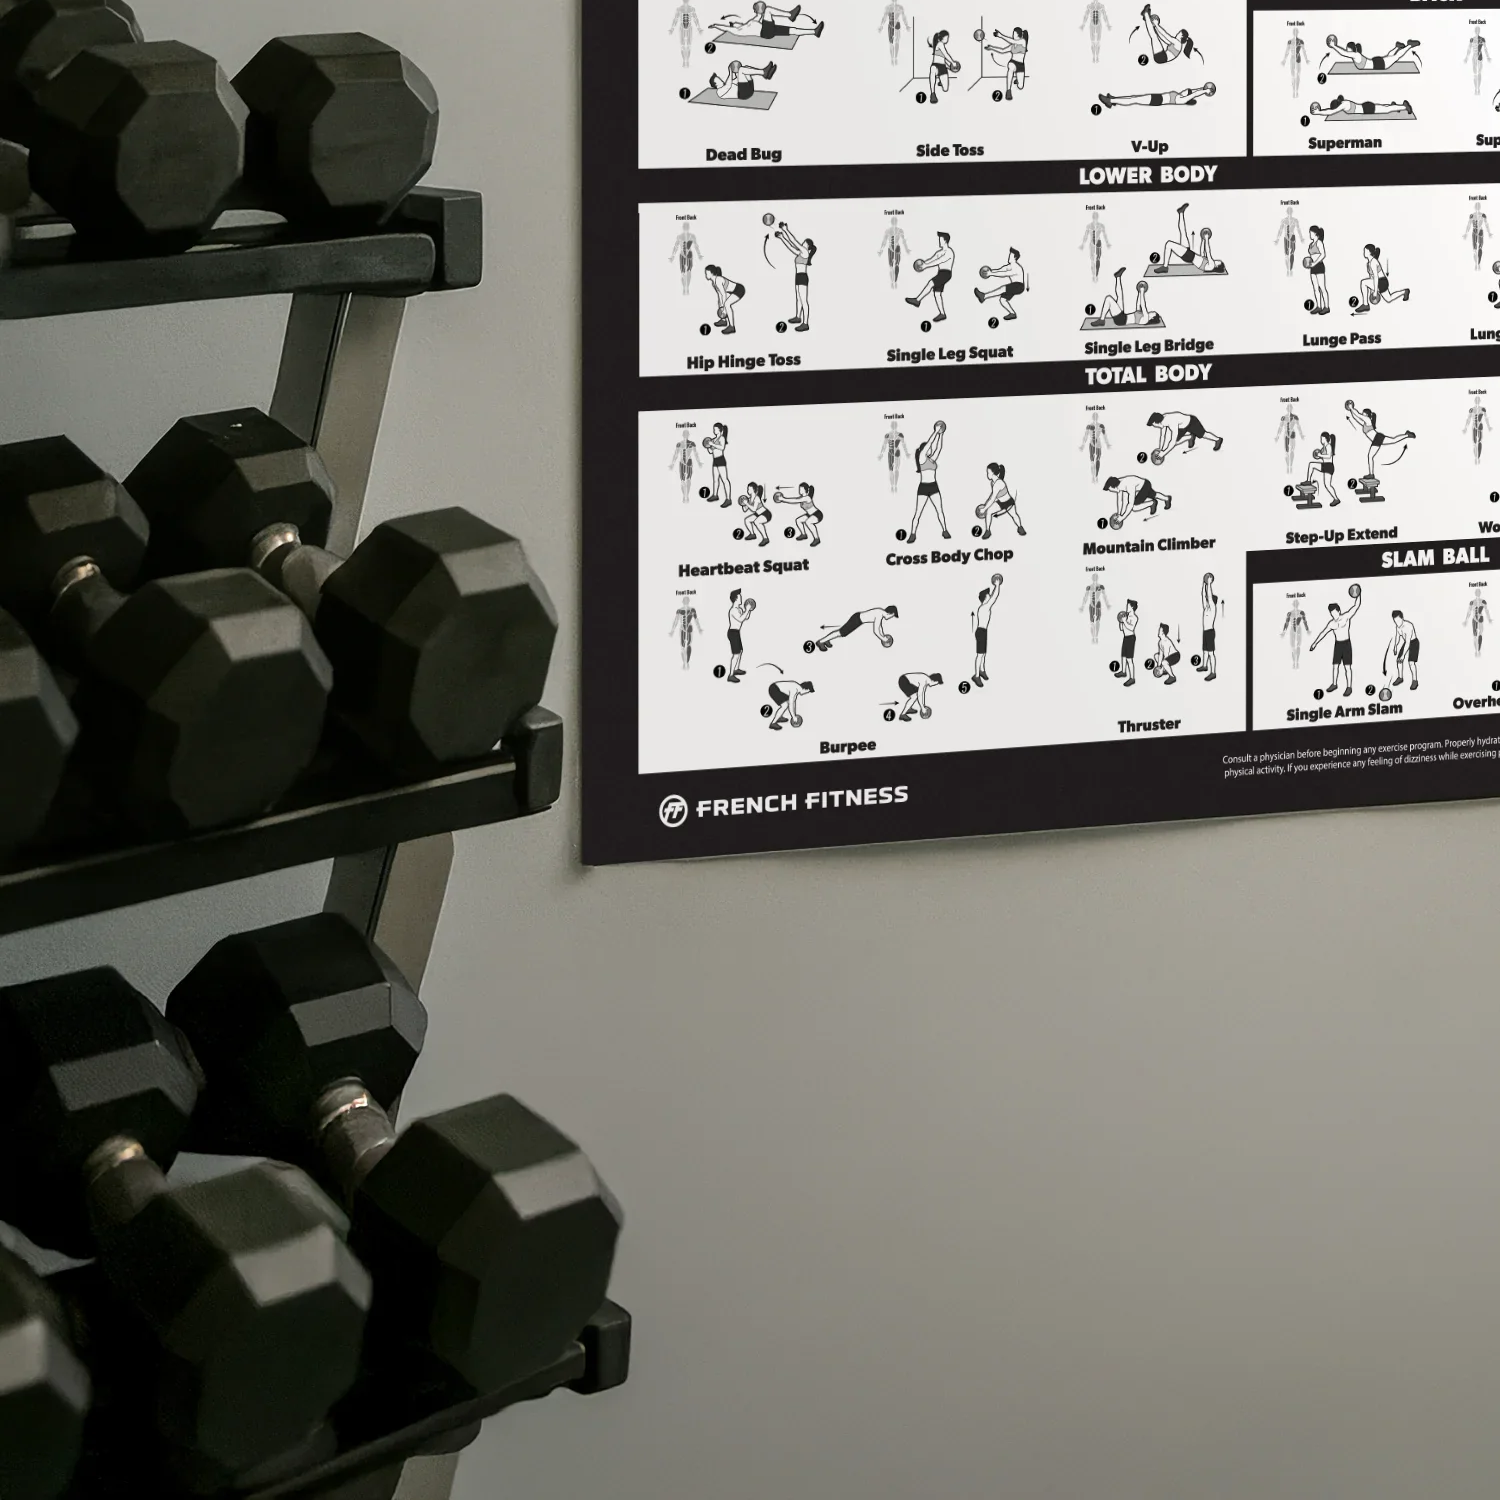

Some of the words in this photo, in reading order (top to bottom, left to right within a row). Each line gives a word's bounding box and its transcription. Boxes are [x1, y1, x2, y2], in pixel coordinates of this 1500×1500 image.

[916, 144, 950, 157] Side
[952, 144, 984, 156] Toss
[1131, 140, 1169, 155] V-Up
[1308, 137, 1382, 152] Superman
[706, 148, 747, 161] Dead
[751, 148, 782, 163] Bug
[1080, 166, 1152, 185] LOWER
[1161, 165, 1218, 183] BODY
[1085, 341, 1132, 356] Single
[1135, 340, 1161, 355] Leg
[1164, 338, 1214, 353] Bridge
[1303, 334, 1347, 348] Lunge
[1350, 333, 1381, 344] Pass
[687, 355, 715, 372] Hip
[718, 354, 765, 370] Hinge
[768, 353, 801, 366] Toss
[887, 348, 935, 364] Single
[939, 347, 966, 362] Leg
[969, 346, 1014, 361] Squat
[1085, 366, 1147, 385] TOTAL
[1155, 363, 1212, 382] BODY
[1286, 530, 1344, 545] Step-Up
[1348, 526, 1398, 541] Extend
[1083, 539, 1154, 555] Mountain
[1157, 537, 1216, 551] Climber
[886, 553, 928, 566] Cross
[931, 550, 971, 565] Body
[974, 548, 1014, 562] Chop
[1381, 549, 1434, 568] SLAM
[1443, 546, 1490, 565] BALL
[679, 561, 760, 577] Heartbeat
[763, 559, 809, 575] Squat
[1287, 707, 1332, 722] Single
[1334, 706, 1365, 718] Arm
[1368, 703, 1403, 715] Slam
[1118, 719, 1181, 733] Thruster
[820, 741, 876, 755] Burpee
[1222, 753, 1252, 764] Consult
[1259, 751, 1295, 763] physician
[1297, 749, 1322, 759] before
[1323, 746, 1362, 758] beginning
[1363, 746, 1377, 755] any
[1378, 743, 1408, 753] exercise
[1409, 741, 1443, 752] program.
[1444, 737, 1476, 748] Properly
[1224, 766, 1255, 779] physical
[1256, 765, 1286, 775] activity.
[1287, 762, 1293, 772] If
[1293, 764, 1308, 774] you
[1309, 761, 1351, 772] experience
[1352, 760, 1366, 769] any
[1367, 757, 1393, 767] feeling
[1394, 754, 1403, 764] of
[1404, 754, 1437, 763] dizziness
[1438, 751, 1459, 761] while
[1460, 749, 1497, 759] exercising
[696, 794, 797, 817] FRENCH
[805, 786, 908, 809] FITNESS
